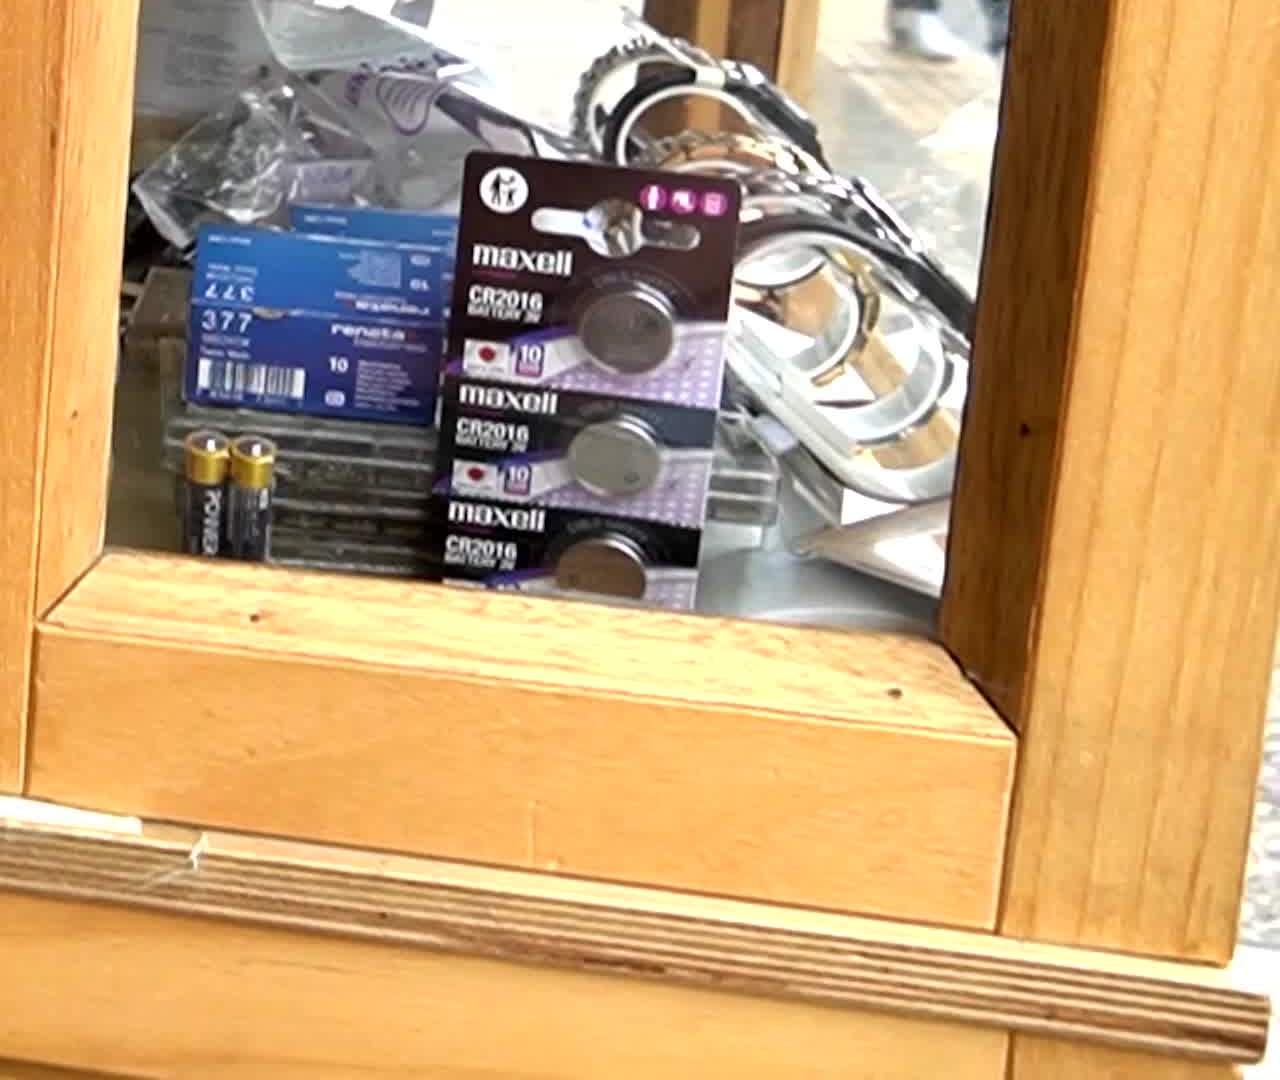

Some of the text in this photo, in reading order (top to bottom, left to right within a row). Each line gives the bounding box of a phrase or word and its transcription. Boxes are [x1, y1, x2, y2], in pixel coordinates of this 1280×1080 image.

[472, 243, 573, 276] maxell
[469, 285, 543, 311] CR2016
[201, 309, 253, 334] 377
[467, 303, 520, 320] BATTERY
[328, 355, 349, 374] 10
[519, 344, 542, 362] 10
[459, 383, 558, 415] maxell
[456, 418, 529, 443] CR2016
[508, 465, 530, 482] 10
[447, 500, 546, 533] maxell
[445, 534, 518, 558] CR2016
